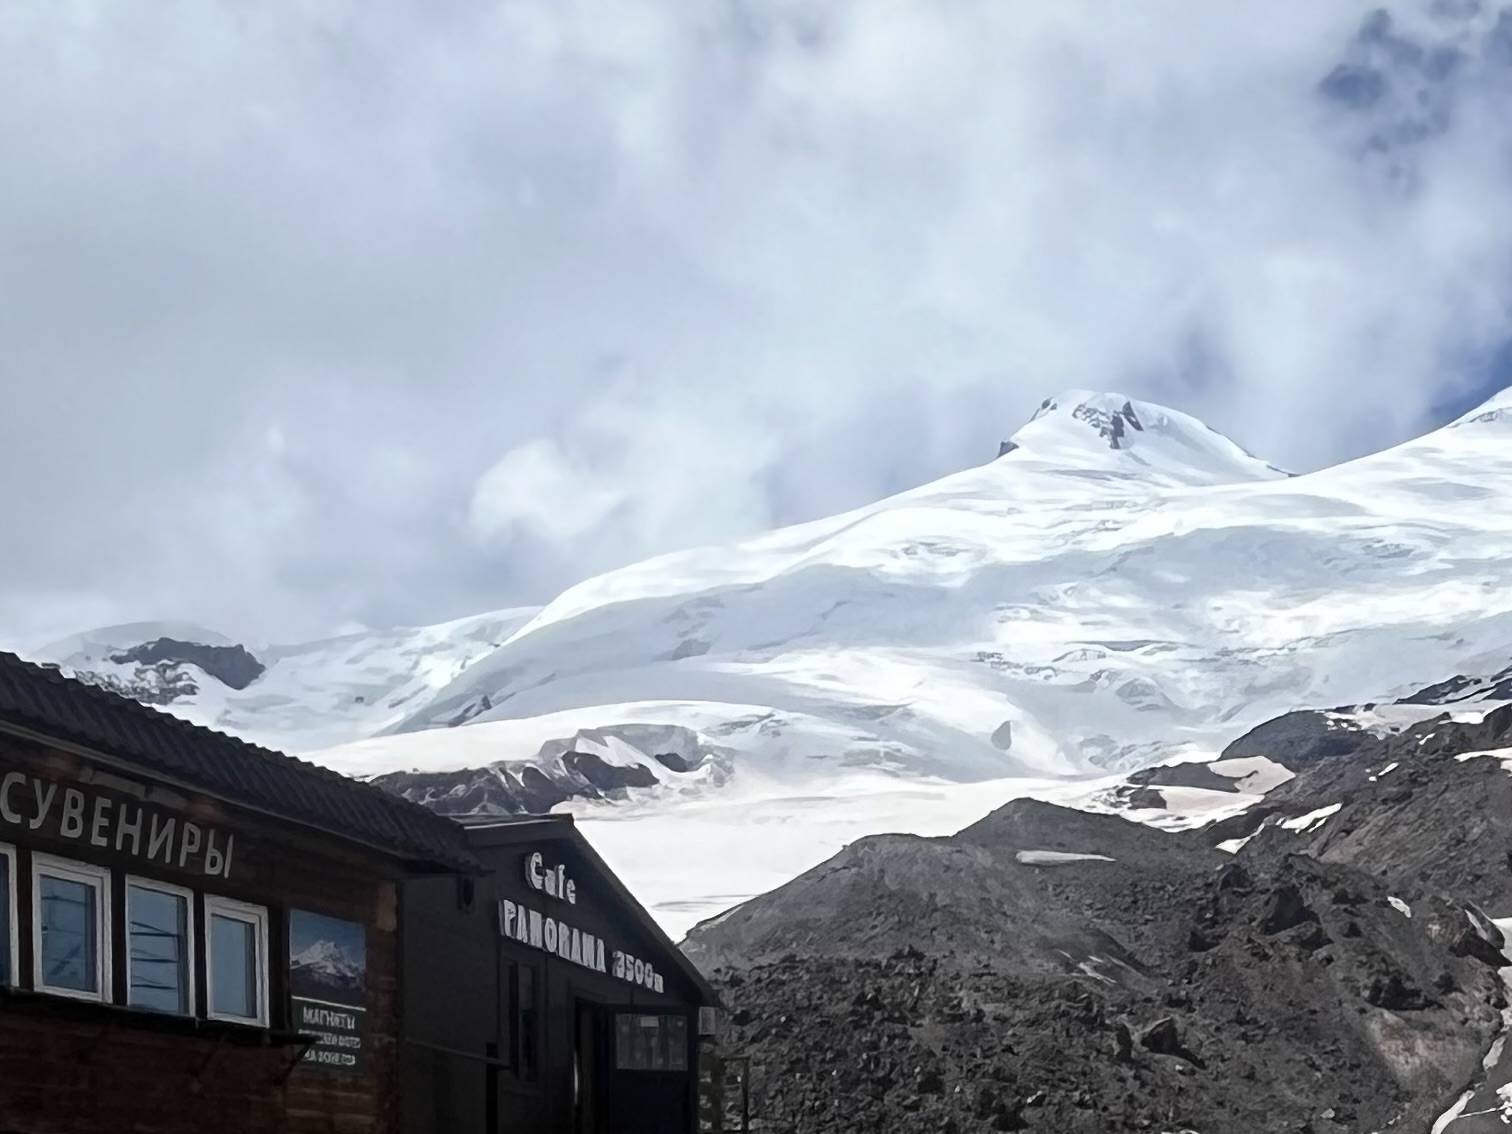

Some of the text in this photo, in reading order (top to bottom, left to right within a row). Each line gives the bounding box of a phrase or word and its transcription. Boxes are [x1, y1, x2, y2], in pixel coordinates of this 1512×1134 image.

[0, 771, 235, 879] СУВЕНИРЫ
[526, 851, 577, 905] Cafe
[499, 899, 607, 973] PANORAMA
